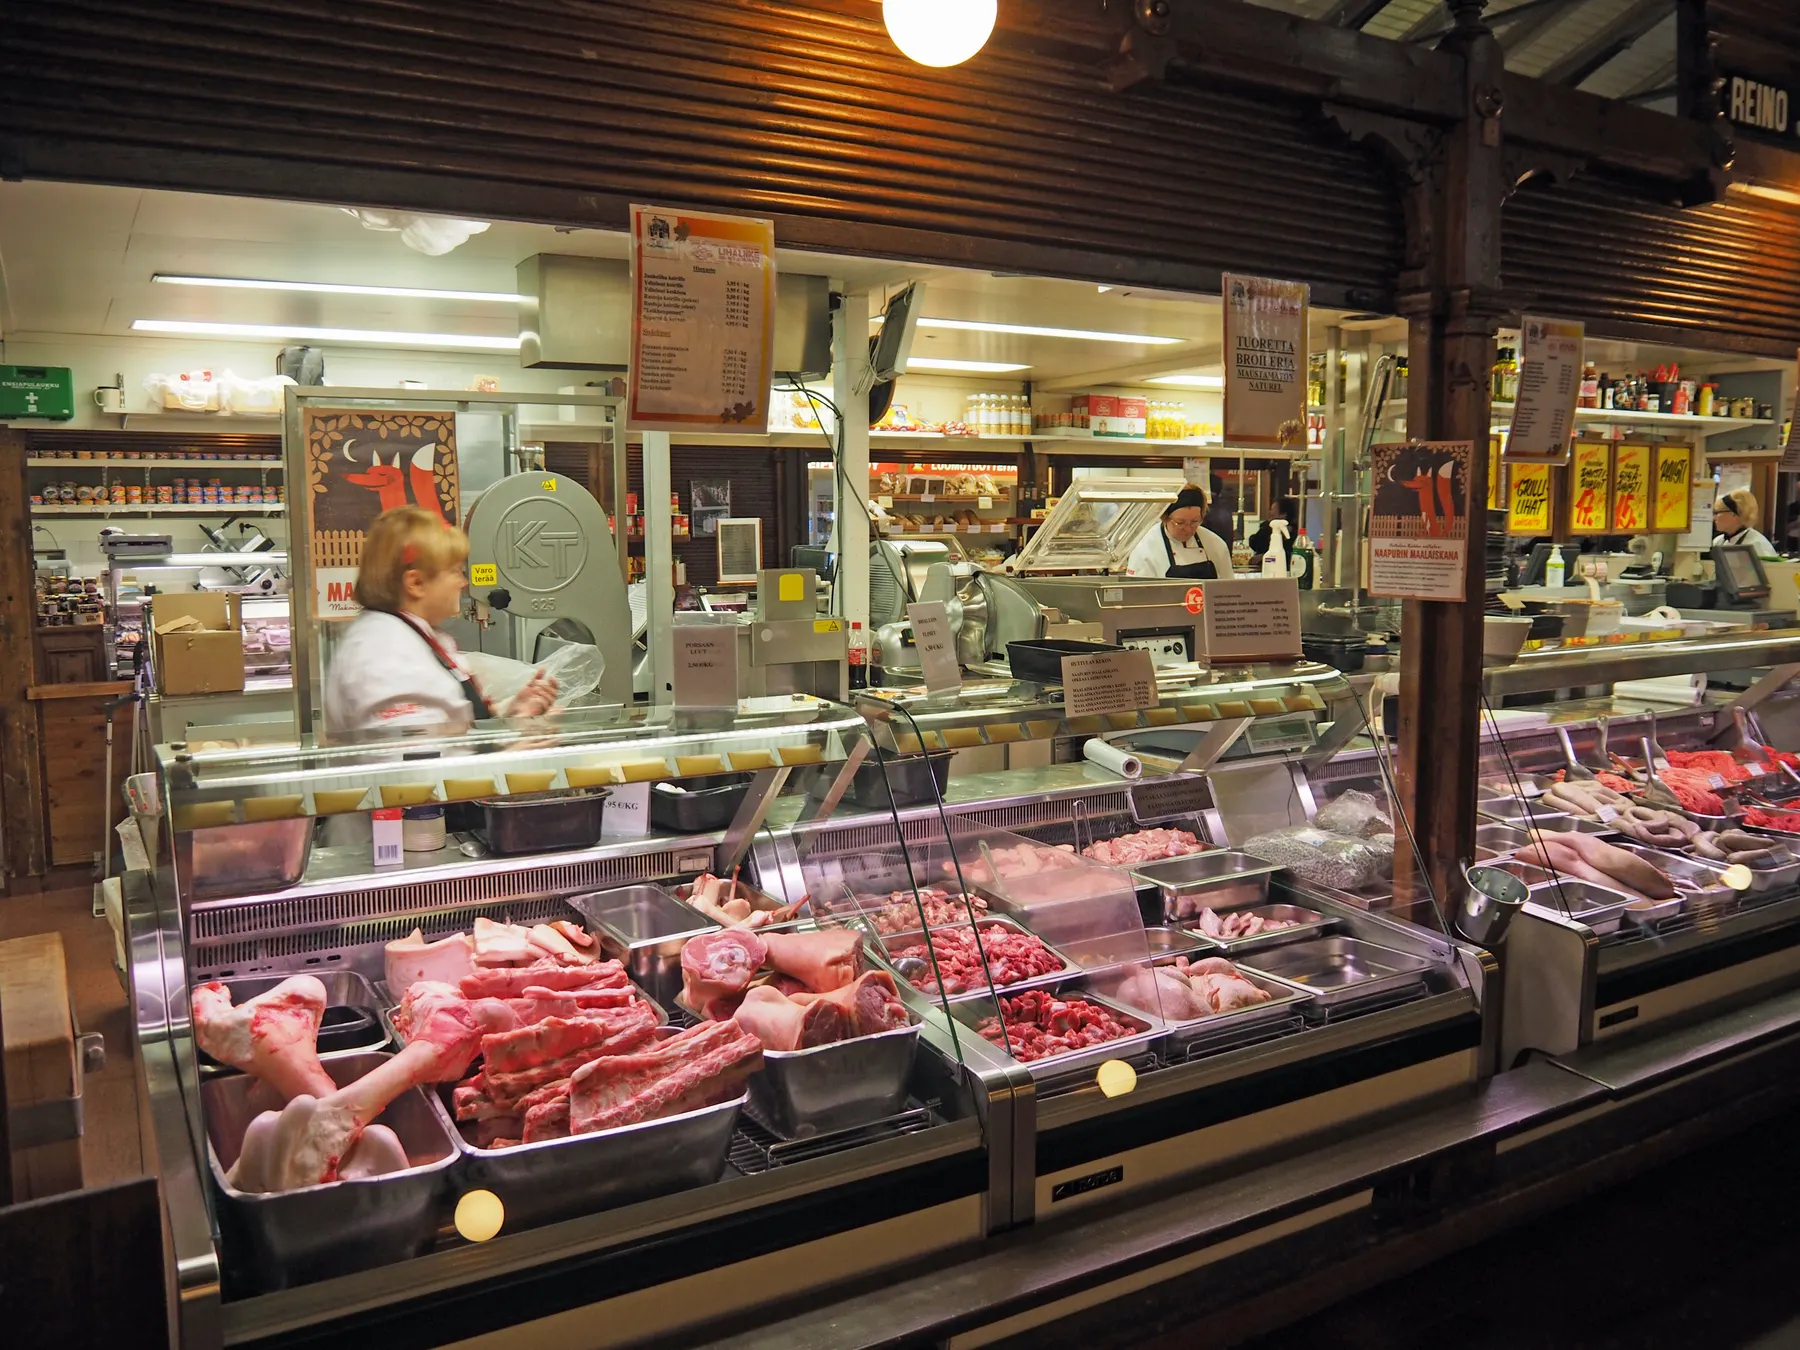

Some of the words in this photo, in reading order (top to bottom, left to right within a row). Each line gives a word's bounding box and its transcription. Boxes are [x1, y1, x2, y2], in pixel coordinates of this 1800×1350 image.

[1731, 76, 1788, 132] REINO
[1236, 336, 1294, 352] TUORETTA
[1236, 353, 1295, 369] BROILERIA
[1238, 368, 1294, 381] MAUSTAMATON
[1516, 498, 1547, 515] LIHAT
[506, 520, 579, 580] KT
[1375, 548, 1409, 559] NAAPURIN
[1410, 550, 1459, 560] MAALAISKANA
[531, 598, 557, 612] 325
[618, 802, 638, 810] €/KG
